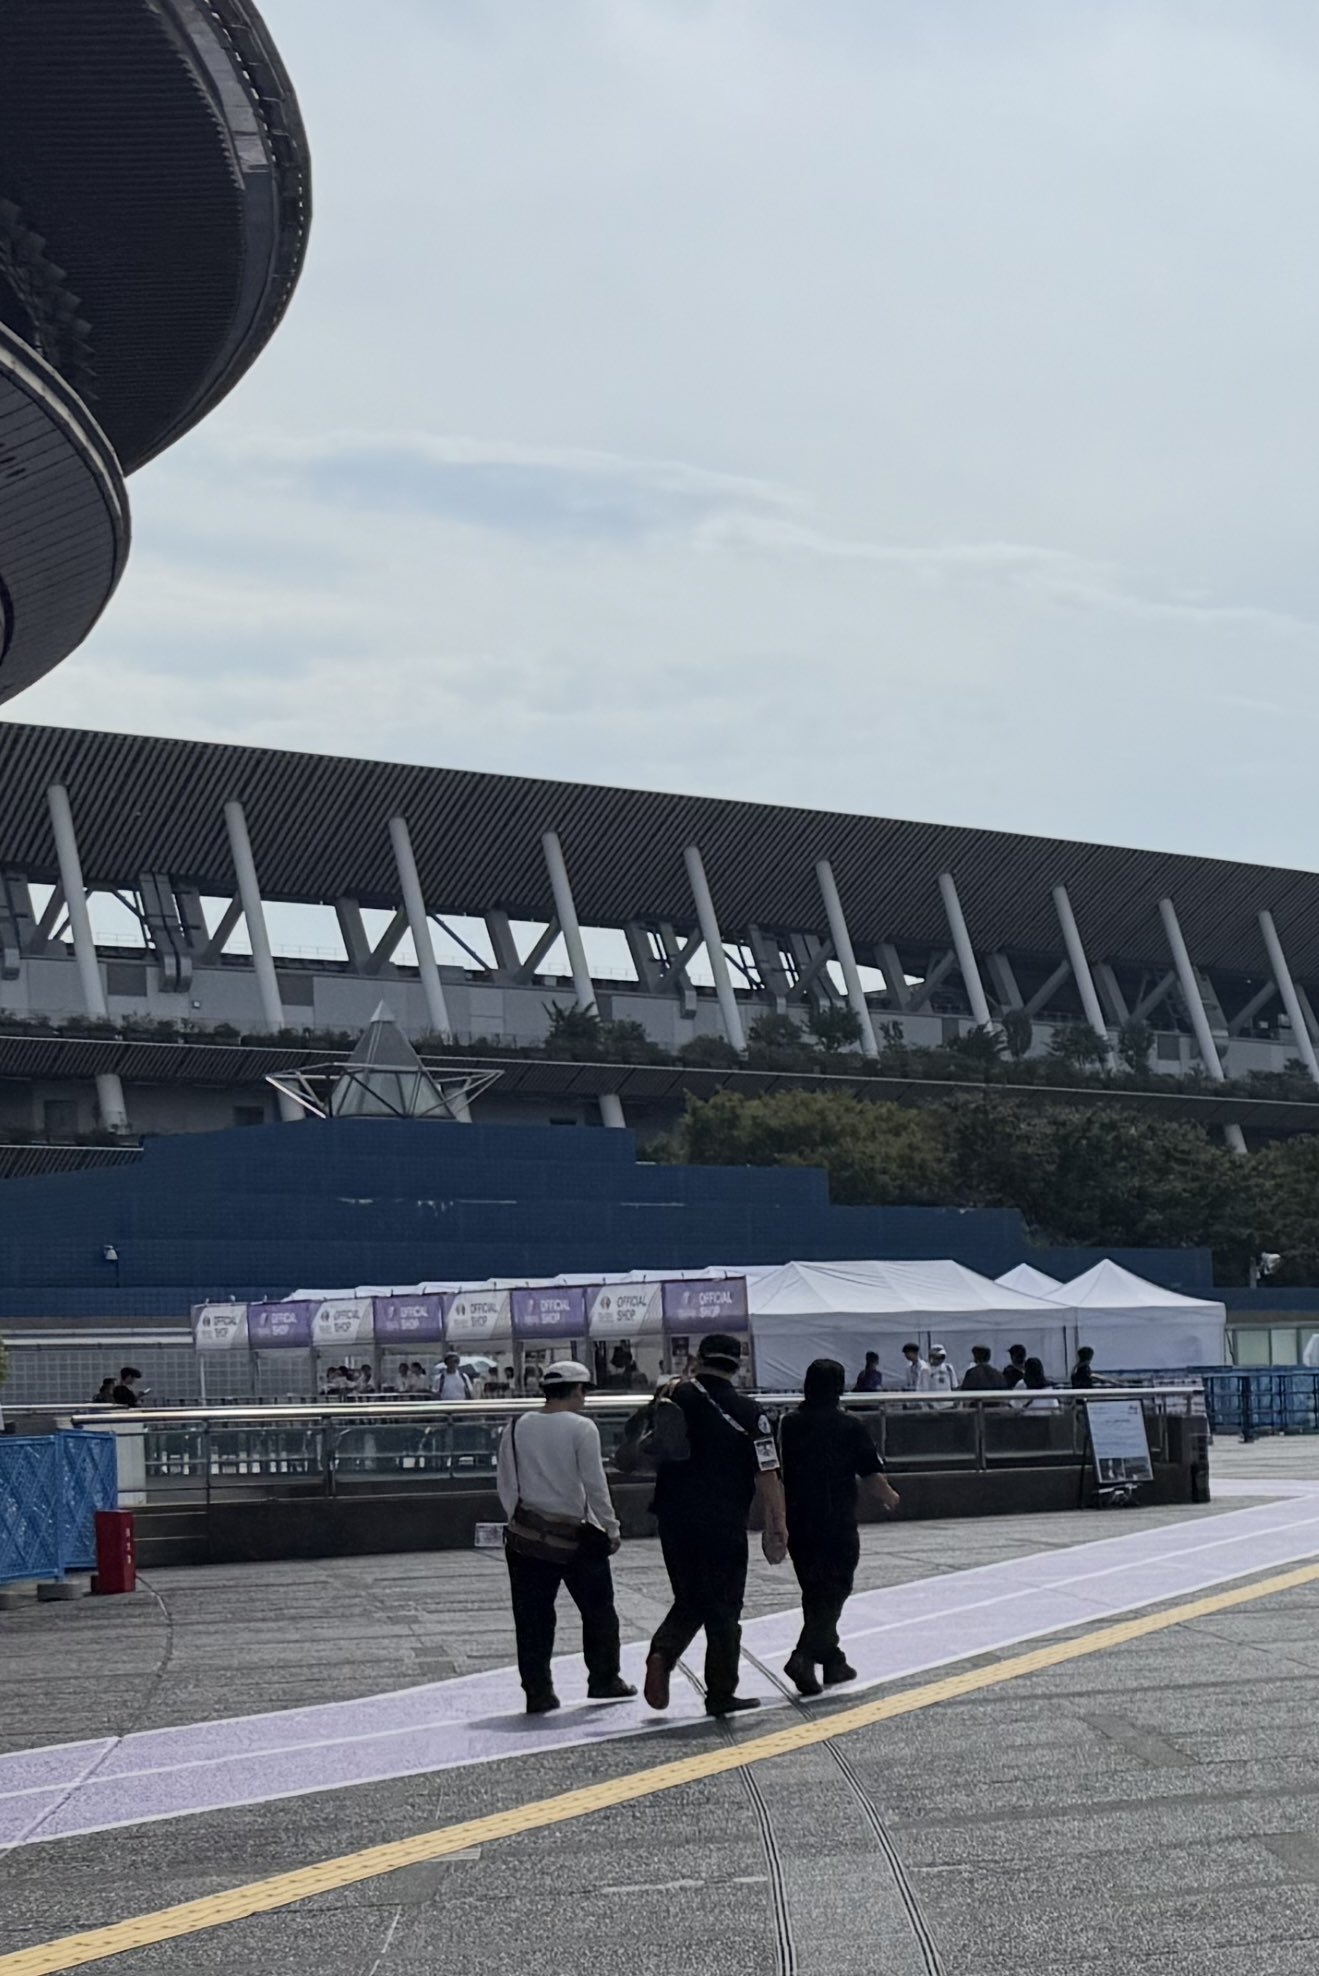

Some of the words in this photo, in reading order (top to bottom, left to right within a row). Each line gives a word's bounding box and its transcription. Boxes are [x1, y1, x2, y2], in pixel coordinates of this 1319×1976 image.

[617, 1295, 647, 1309] OFFICIAL
[699, 1291, 733, 1305] OFFICIAL
[617, 1309, 636, 1322] SHOP
